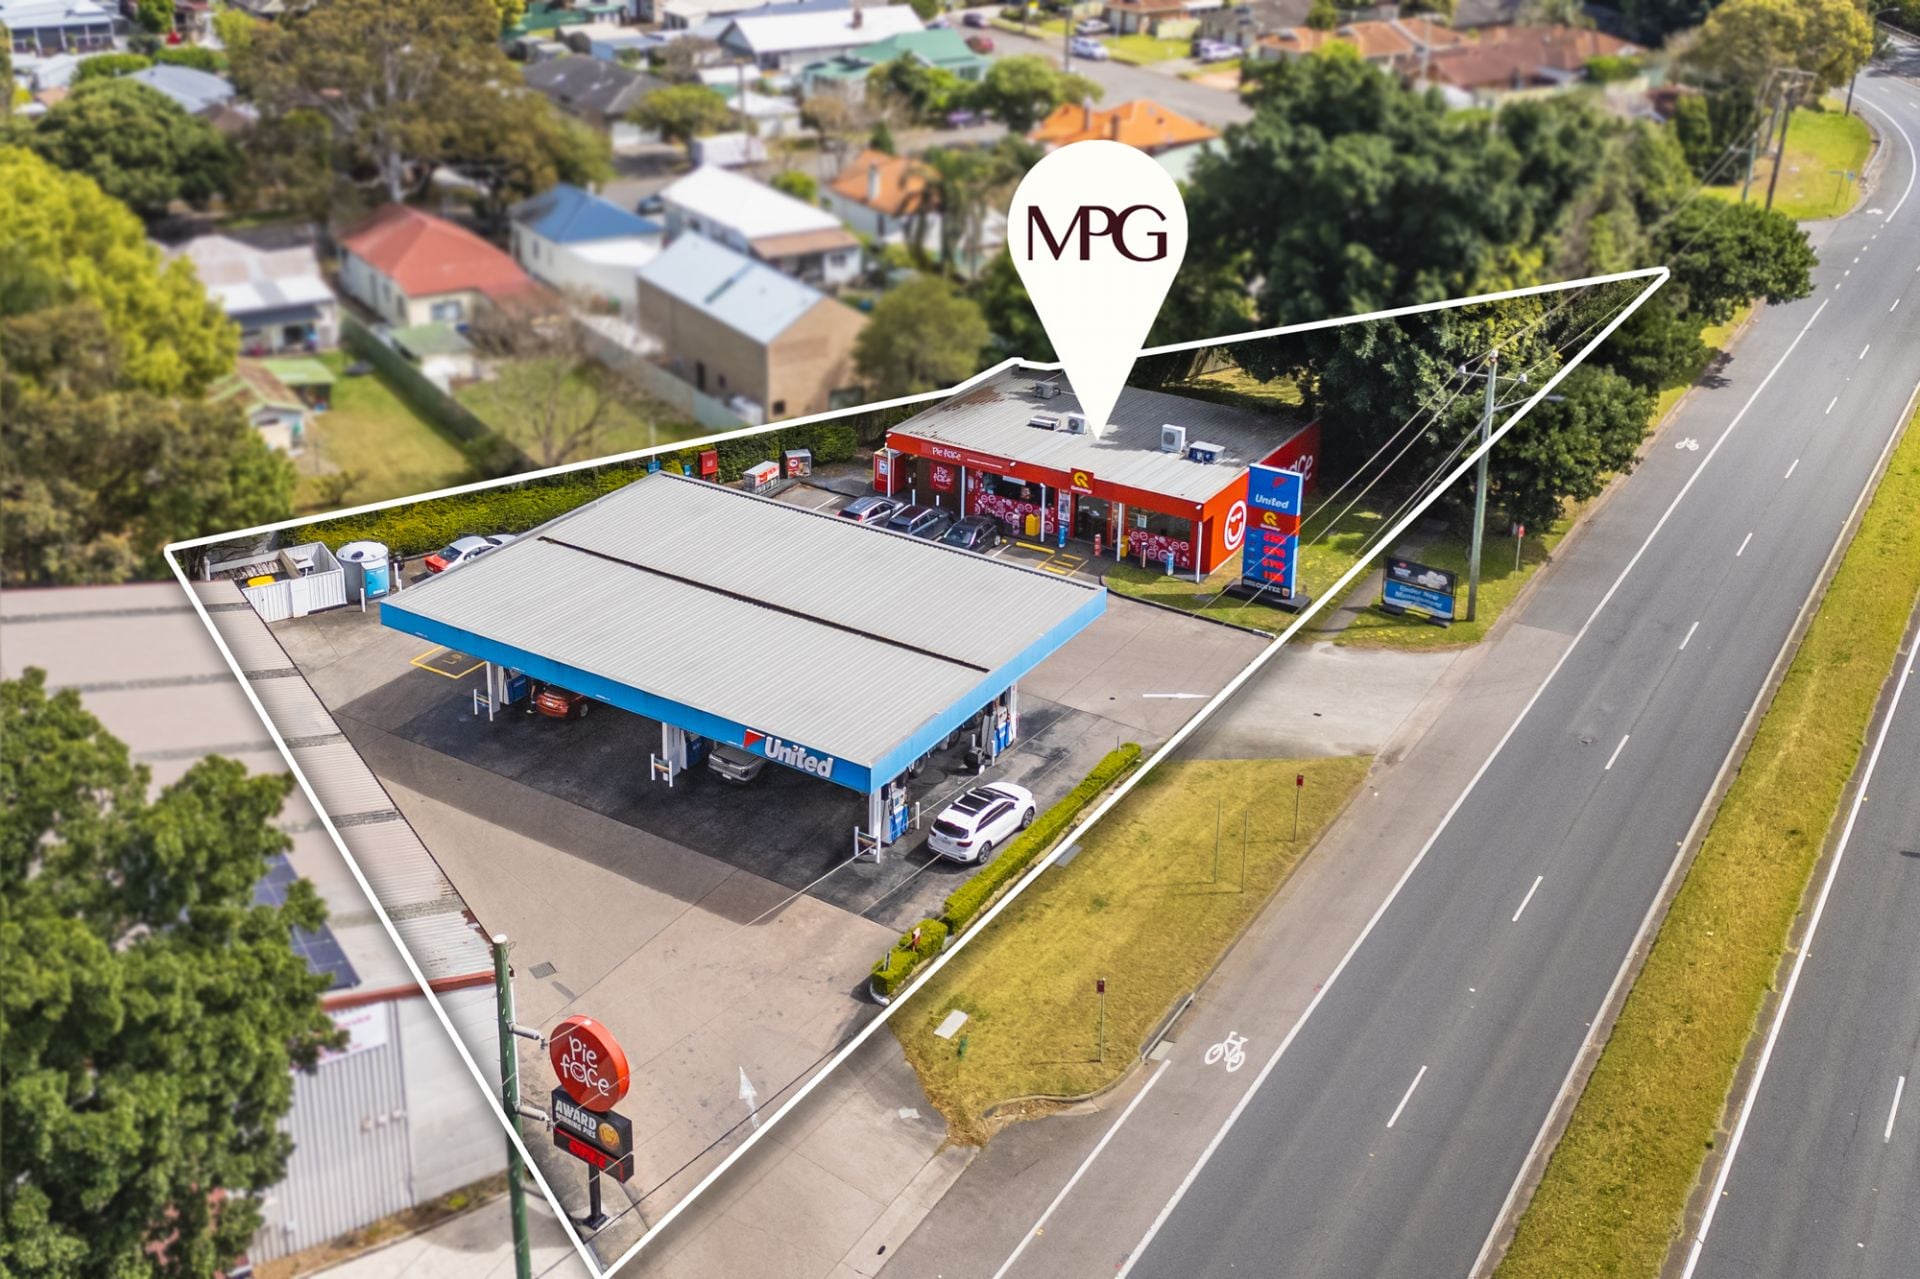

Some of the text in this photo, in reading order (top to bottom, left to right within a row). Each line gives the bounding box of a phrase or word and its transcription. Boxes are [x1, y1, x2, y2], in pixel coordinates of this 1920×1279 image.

[1255, 493, 1290, 509] United
[764, 736, 834, 778] United
[559, 1053, 610, 1097] face
[555, 1099, 597, 1131] AWARD
